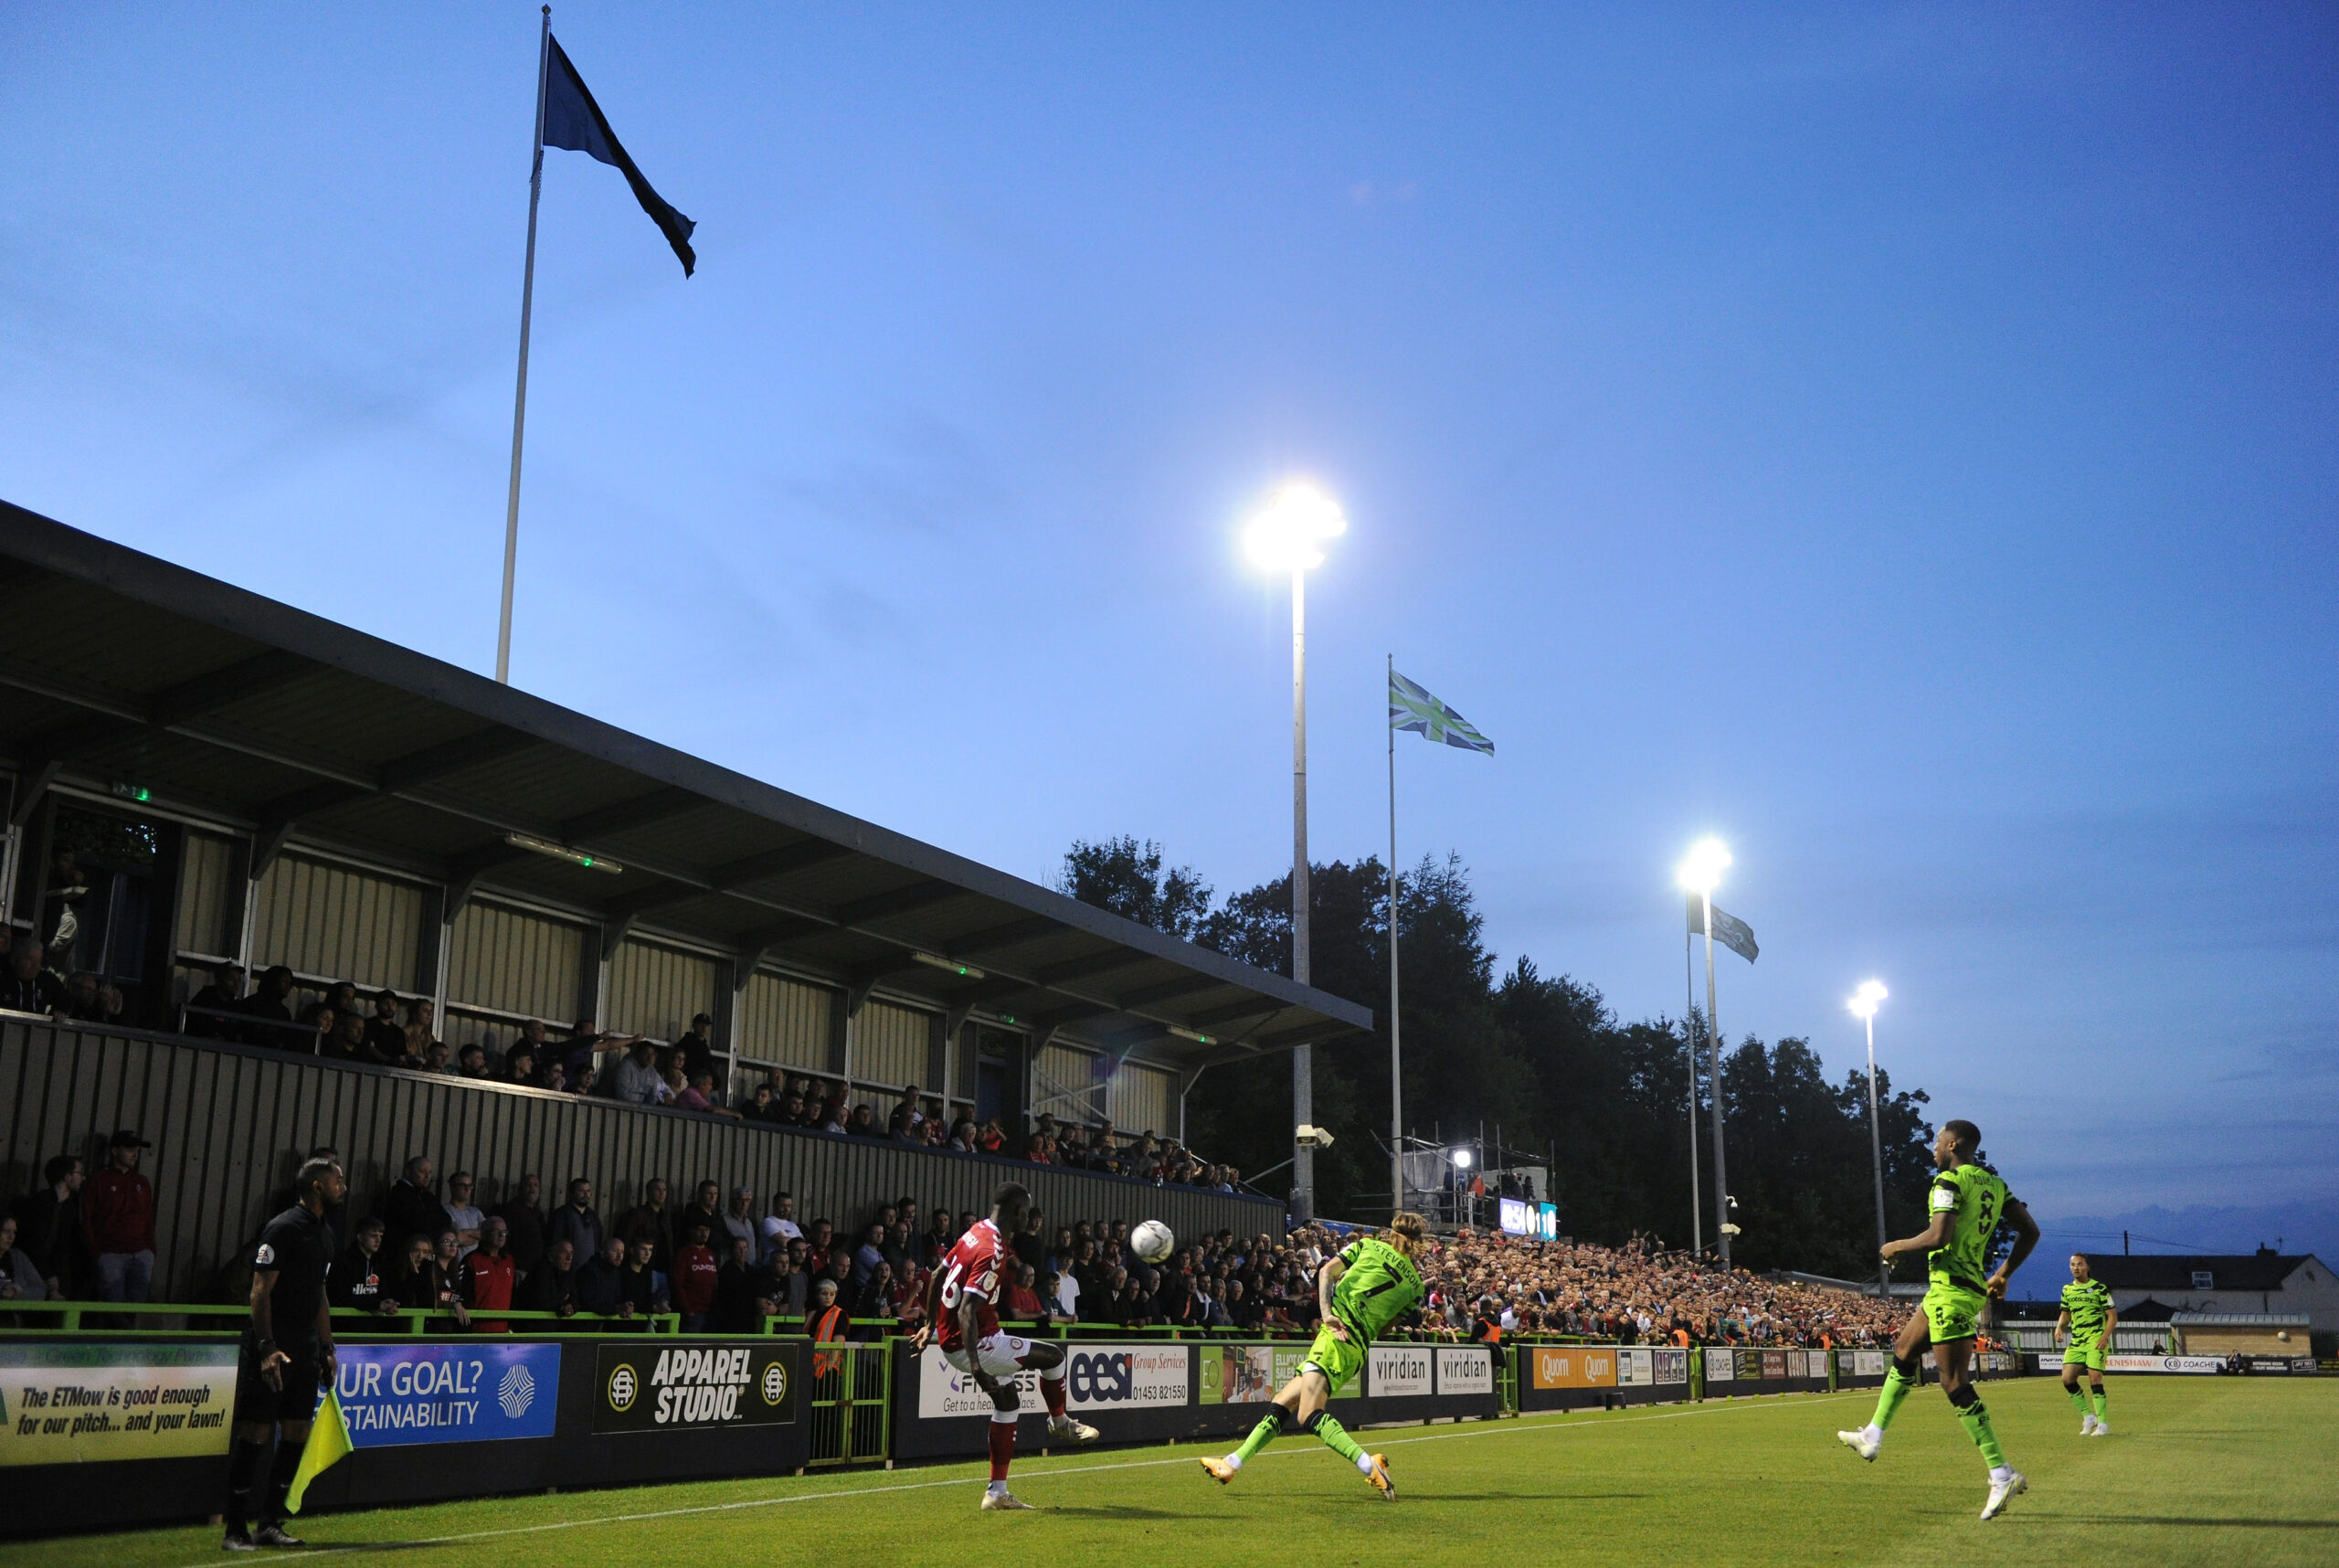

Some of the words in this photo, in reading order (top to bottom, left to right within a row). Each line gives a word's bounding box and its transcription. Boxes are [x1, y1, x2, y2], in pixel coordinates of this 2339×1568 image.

[1978, 1189, 1995, 1235] 8
[1363, 1261, 1403, 1298] 7
[1373, 1244, 1421, 1289] STEVENSON
[650, 1349, 752, 1386] APPAREL
[1133, 1352, 1158, 1373] Group
[1158, 1352, 1187, 1370] Services
[1376, 1352, 1425, 1380] viridian
[1444, 1353, 1487, 1378] viridian
[1541, 1353, 1570, 1383] Quorn
[1584, 1354, 1609, 1383] Quorn
[391, 1361, 484, 1397] GOAL?
[1133, 1386, 1158, 1401] 01453
[1159, 1385, 1187, 1400] 821550
[21, 1387, 48, 1408] The
[51, 1386, 105, 1407] ETMow
[107, 1386, 121, 1406] is
[122, 1385, 161, 1410] good
[161, 1384, 211, 1408] enough
[654, 1384, 738, 1424] STUDIO
[943, 1397, 958, 1413] Get
[960, 1399, 968, 1411] to
[969, 1400, 976, 1411] a
[16, 1414, 43, 1436] for
[42, 1415, 69, 1436] our
[69, 1412, 122, 1438] pitch...
[124, 1411, 154, 1431] and
[153, 1415, 186, 1434] your
[187, 1408, 227, 1429] lawn!
